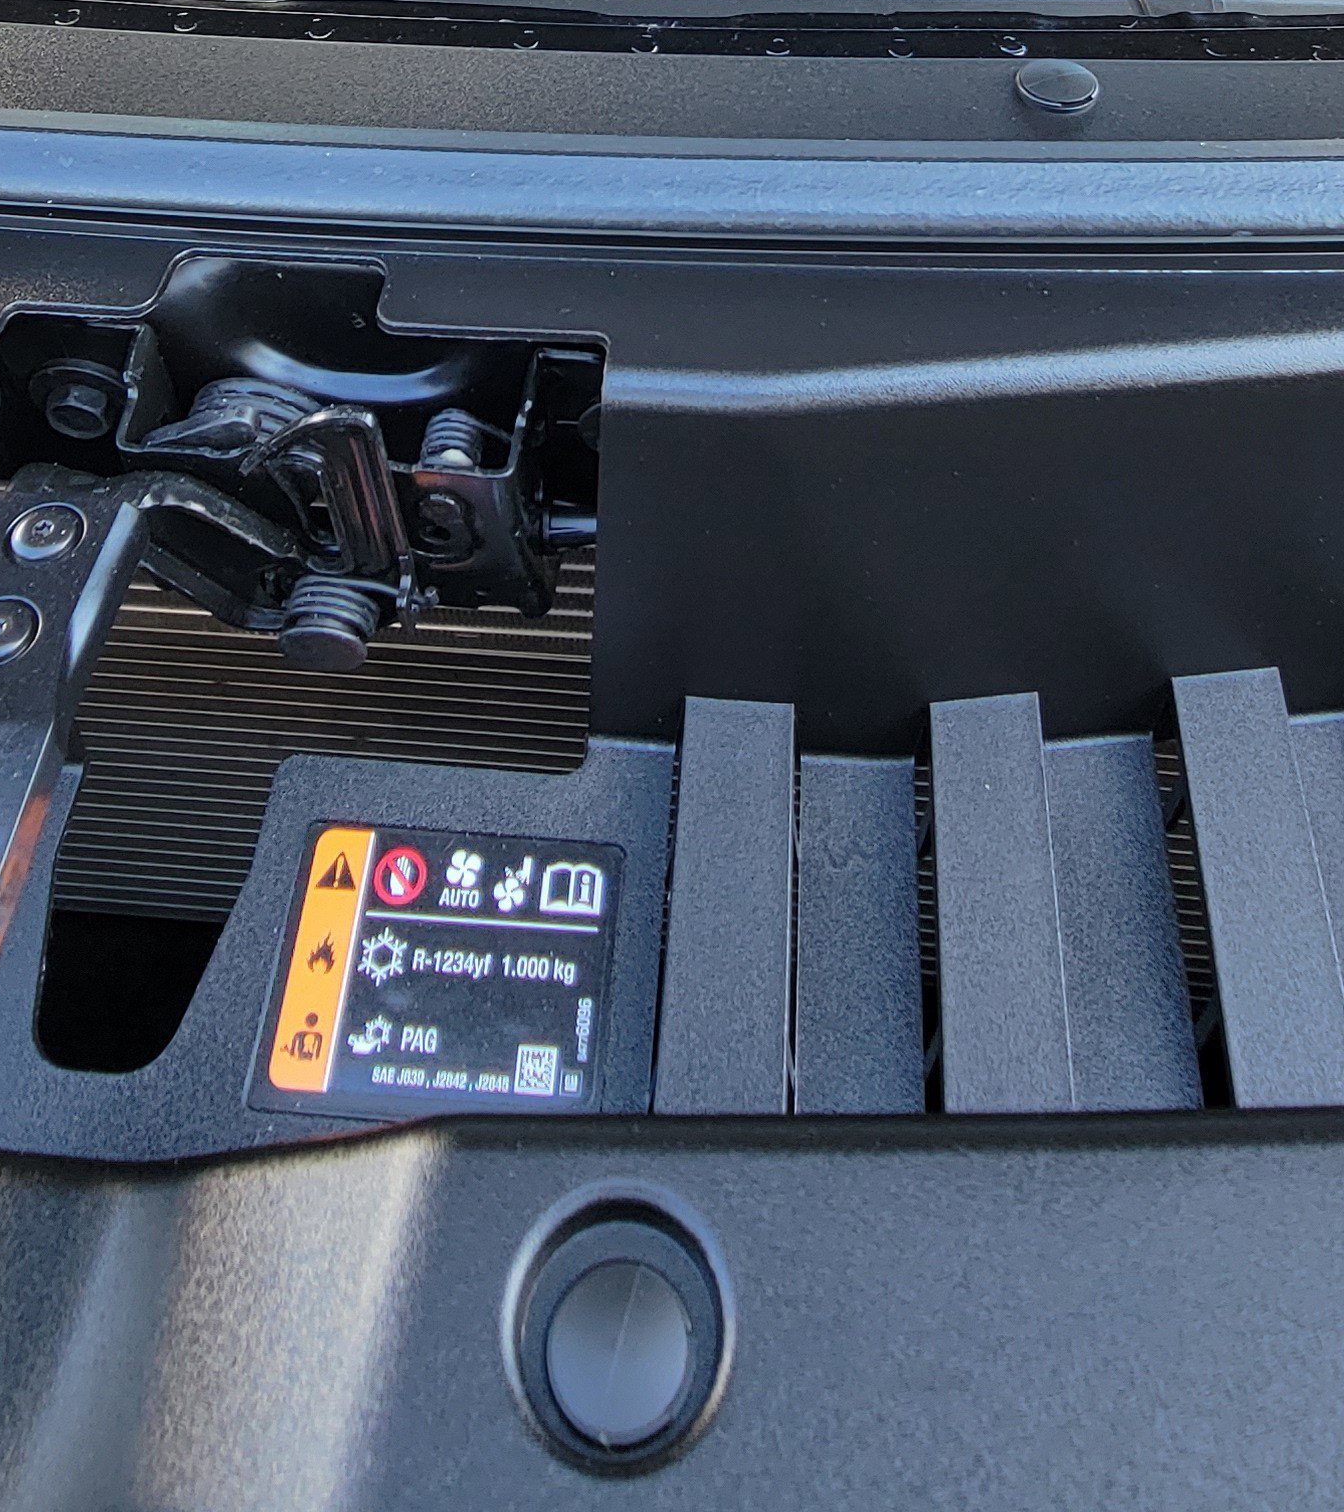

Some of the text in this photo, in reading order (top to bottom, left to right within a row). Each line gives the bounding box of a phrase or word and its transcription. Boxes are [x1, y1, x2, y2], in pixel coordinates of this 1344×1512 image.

[438, 887, 481, 909] AUTO
[412, 948, 576, 987] R-1234yf 1.000 kg
[400, 1025, 438, 1055] PAG
[371, 1065, 395, 1085] SAE
